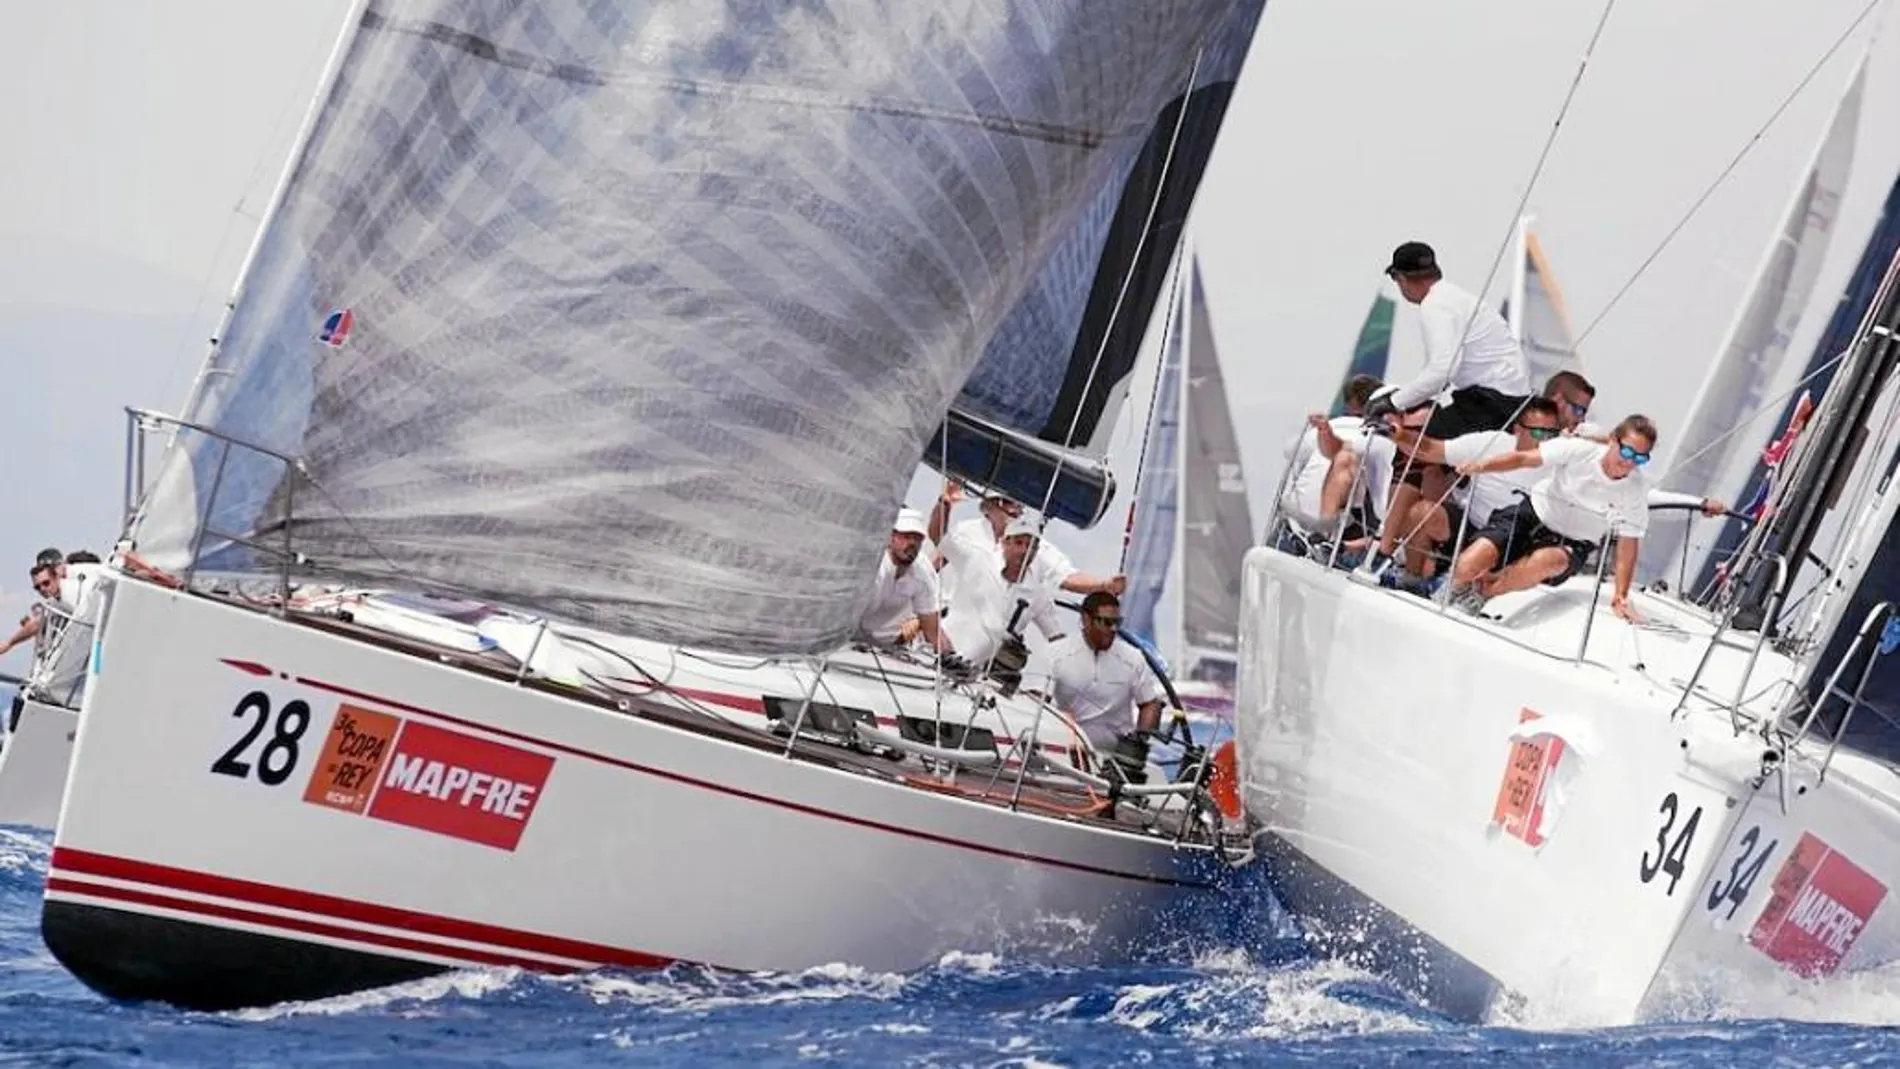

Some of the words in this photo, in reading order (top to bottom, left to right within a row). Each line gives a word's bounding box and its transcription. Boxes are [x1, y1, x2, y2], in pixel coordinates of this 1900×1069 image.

[211, 691, 310, 786] 28
[338, 731, 386, 763] COPA
[333, 762, 372, 789] REY
[385, 753, 536, 820] MAPFRE
[1641, 792, 1703, 896] 34
[1708, 826, 1778, 920] 34
[1788, 884, 1863, 955] MAPFRE
